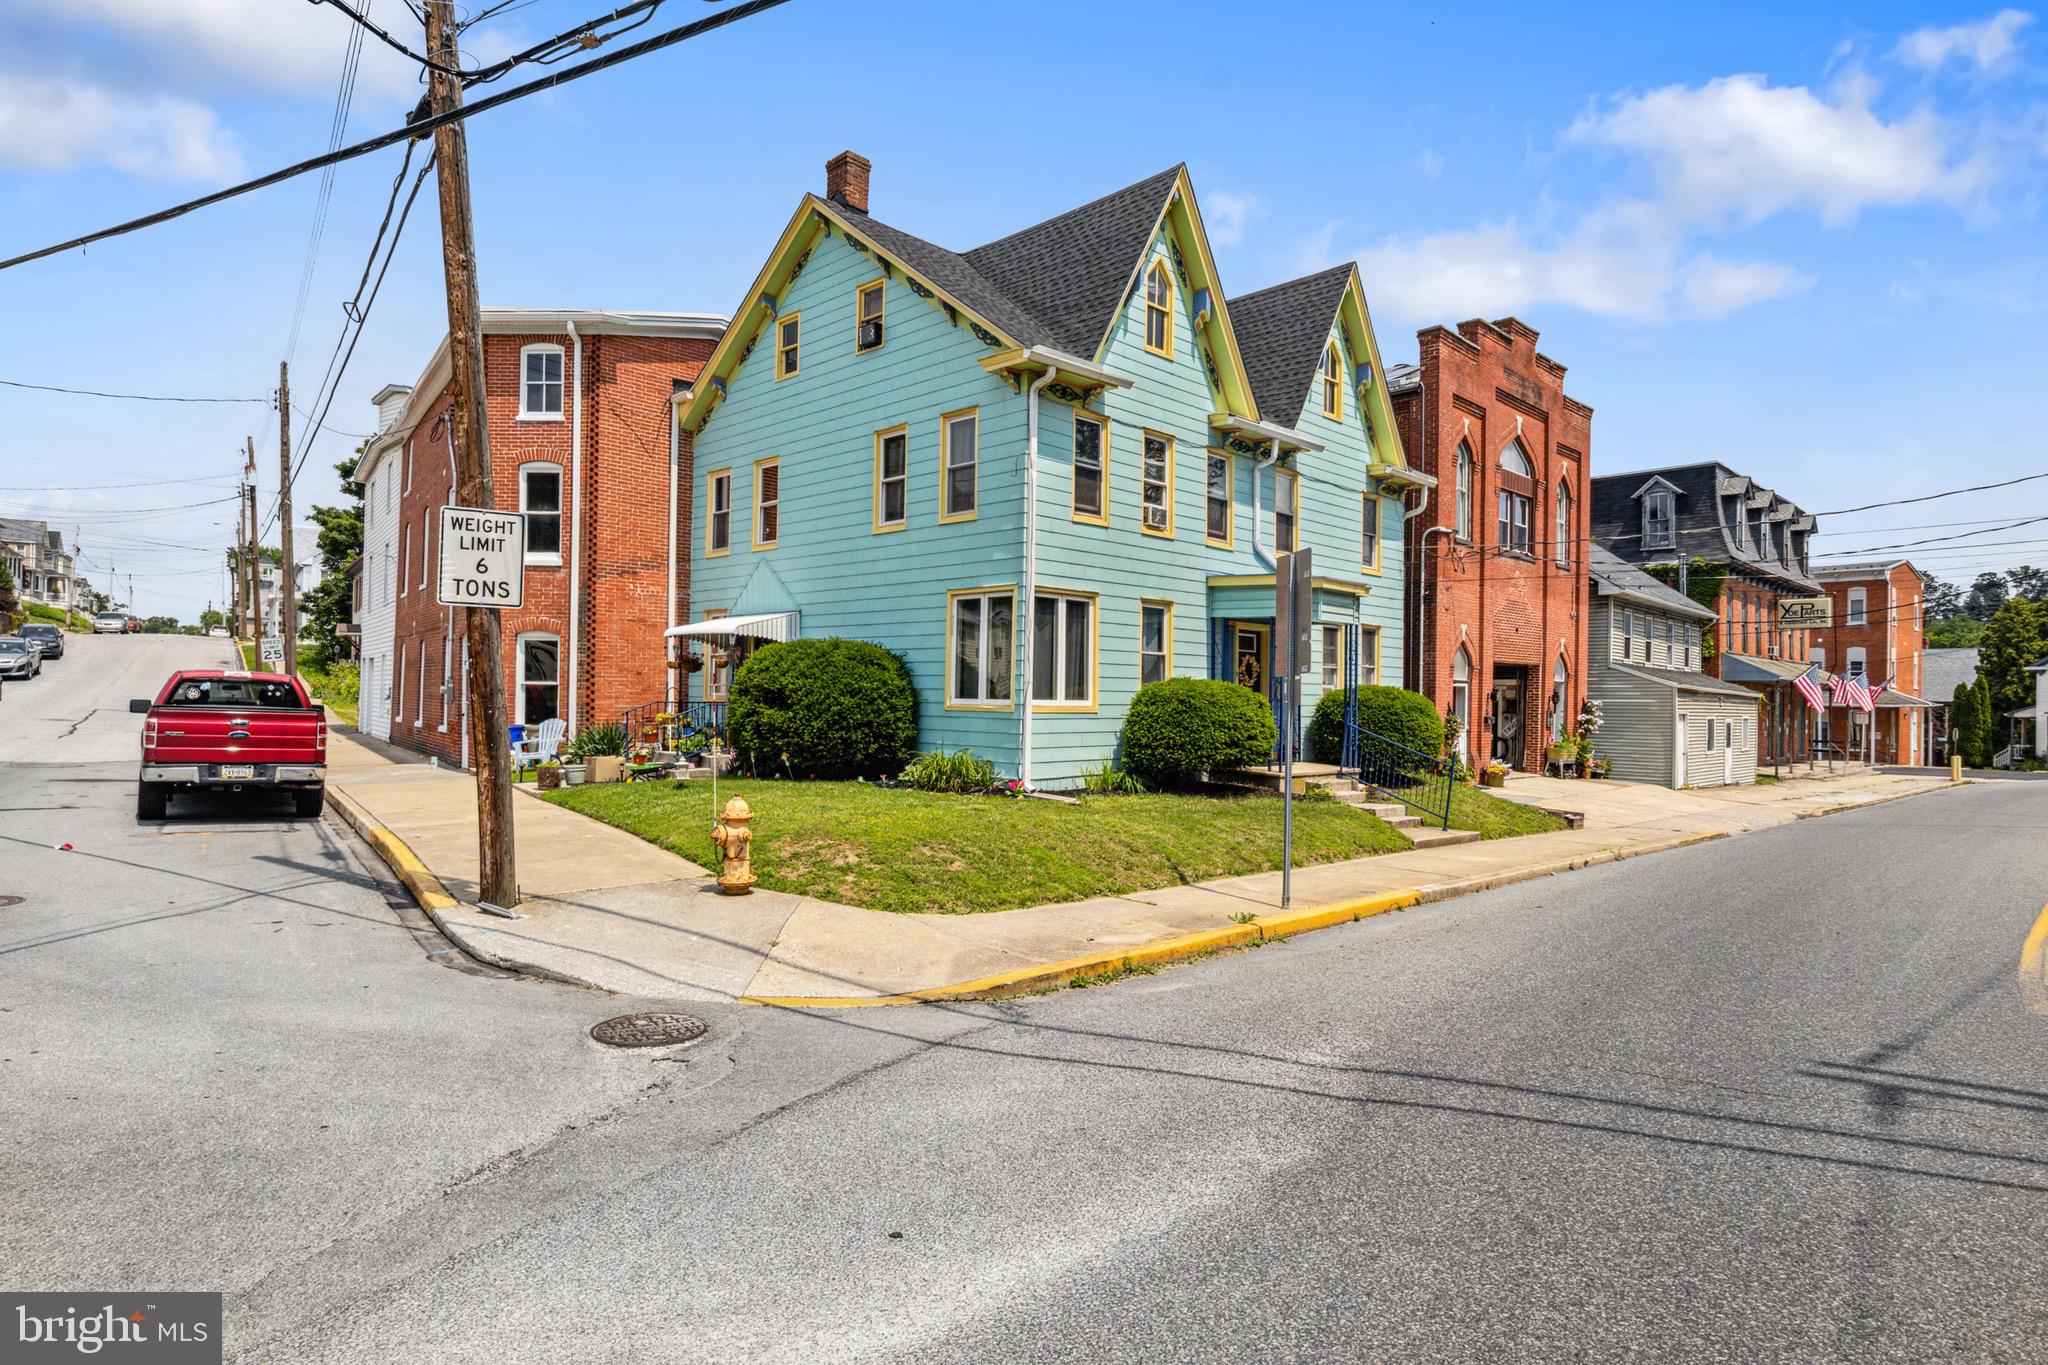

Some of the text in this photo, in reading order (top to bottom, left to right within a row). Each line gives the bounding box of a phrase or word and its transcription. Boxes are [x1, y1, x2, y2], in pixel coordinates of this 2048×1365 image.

[451, 516, 516, 535] WEIGHT
[460, 536, 505, 552] LIMIT
[476, 558, 488, 574] 6
[452, 579, 510, 598] TONS
[263, 650, 283, 660] 25
